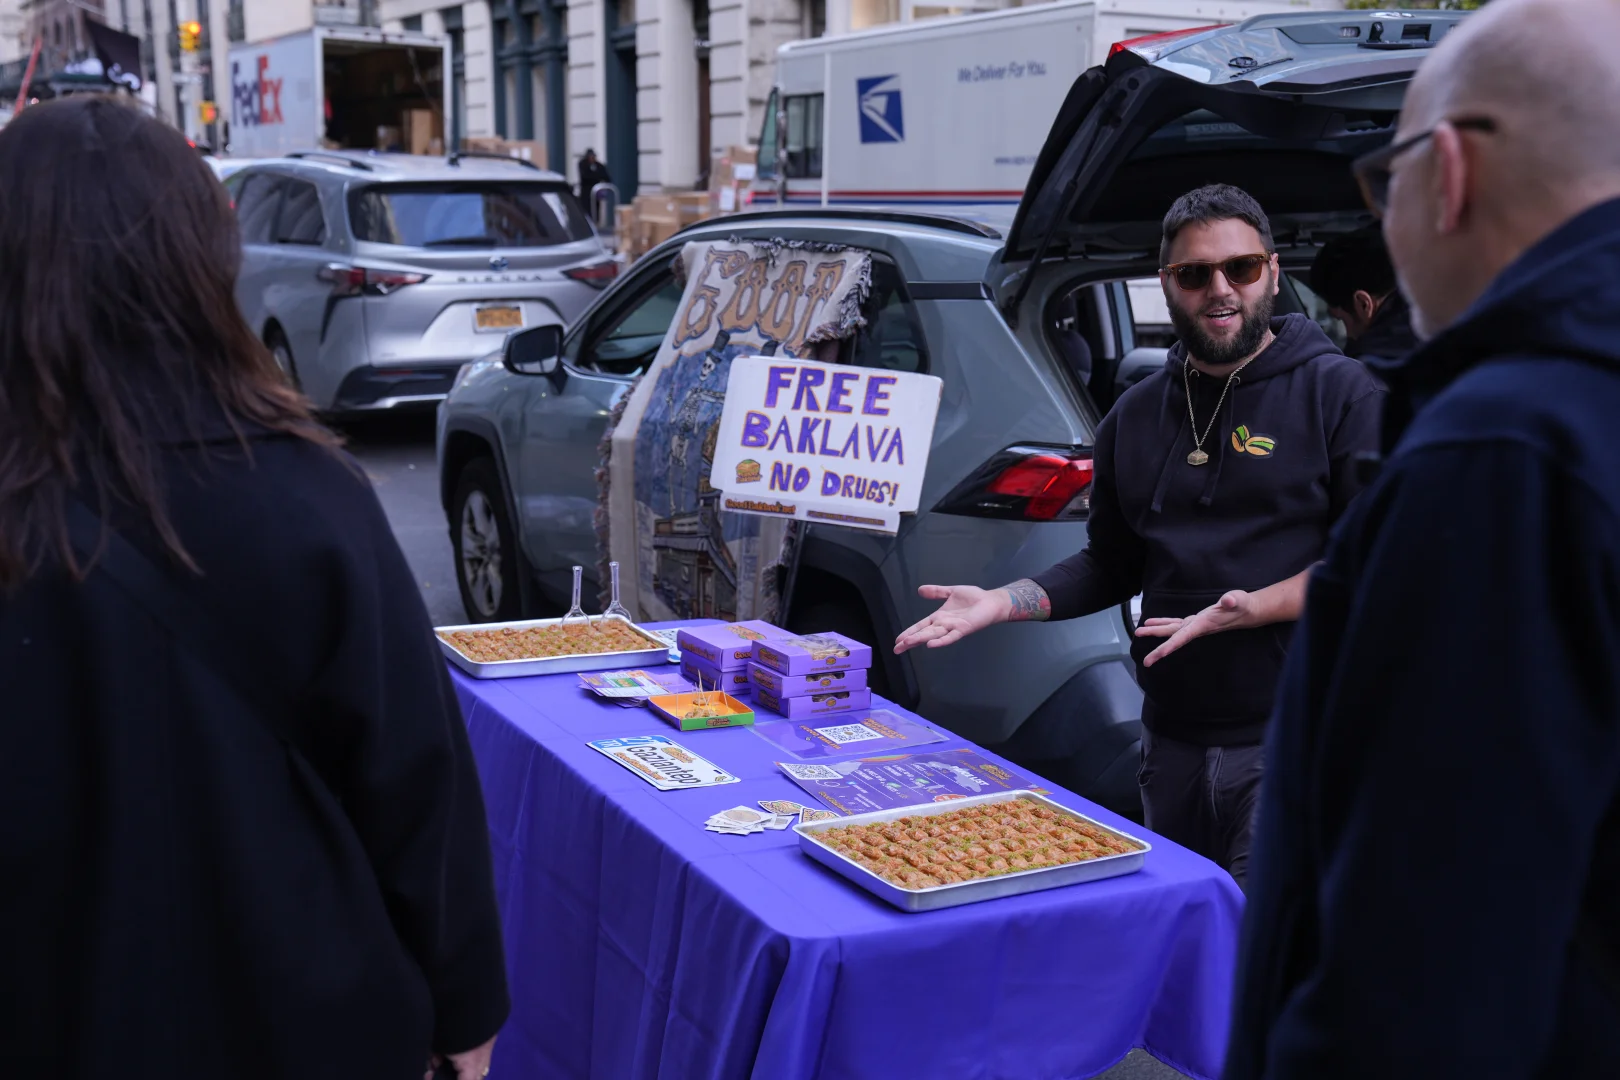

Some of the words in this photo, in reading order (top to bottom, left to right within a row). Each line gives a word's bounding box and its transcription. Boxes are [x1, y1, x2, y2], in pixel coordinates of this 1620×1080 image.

[763, 365, 898, 417] FREE
[740, 410, 904, 465] BAKLAVA
[769, 460, 811, 492] NO
[820, 469, 901, 506] DRUGS!
[626, 745, 702, 785] Gaziantep
